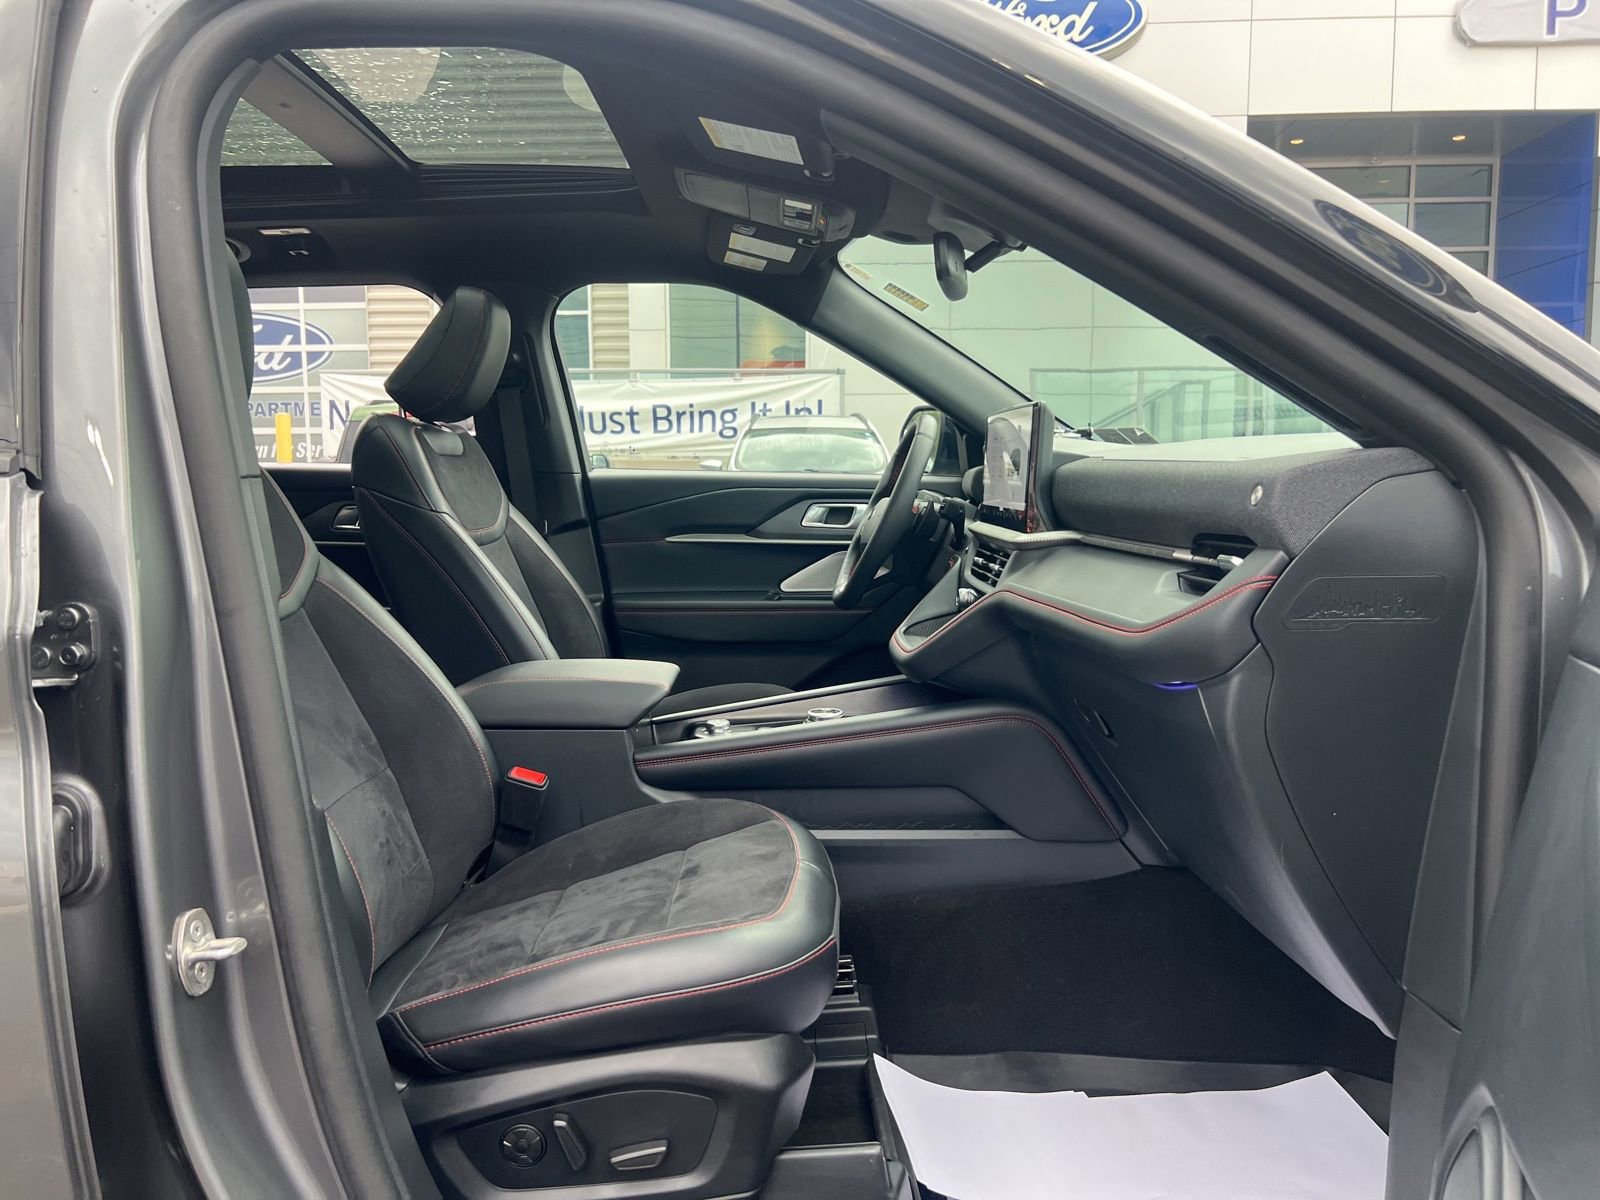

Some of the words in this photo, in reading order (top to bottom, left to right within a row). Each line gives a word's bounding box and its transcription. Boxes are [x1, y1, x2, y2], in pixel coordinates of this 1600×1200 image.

[981, 0, 1098, 42] rd
[579, 405, 641, 435] Just
[652, 403, 738, 439] Bring
